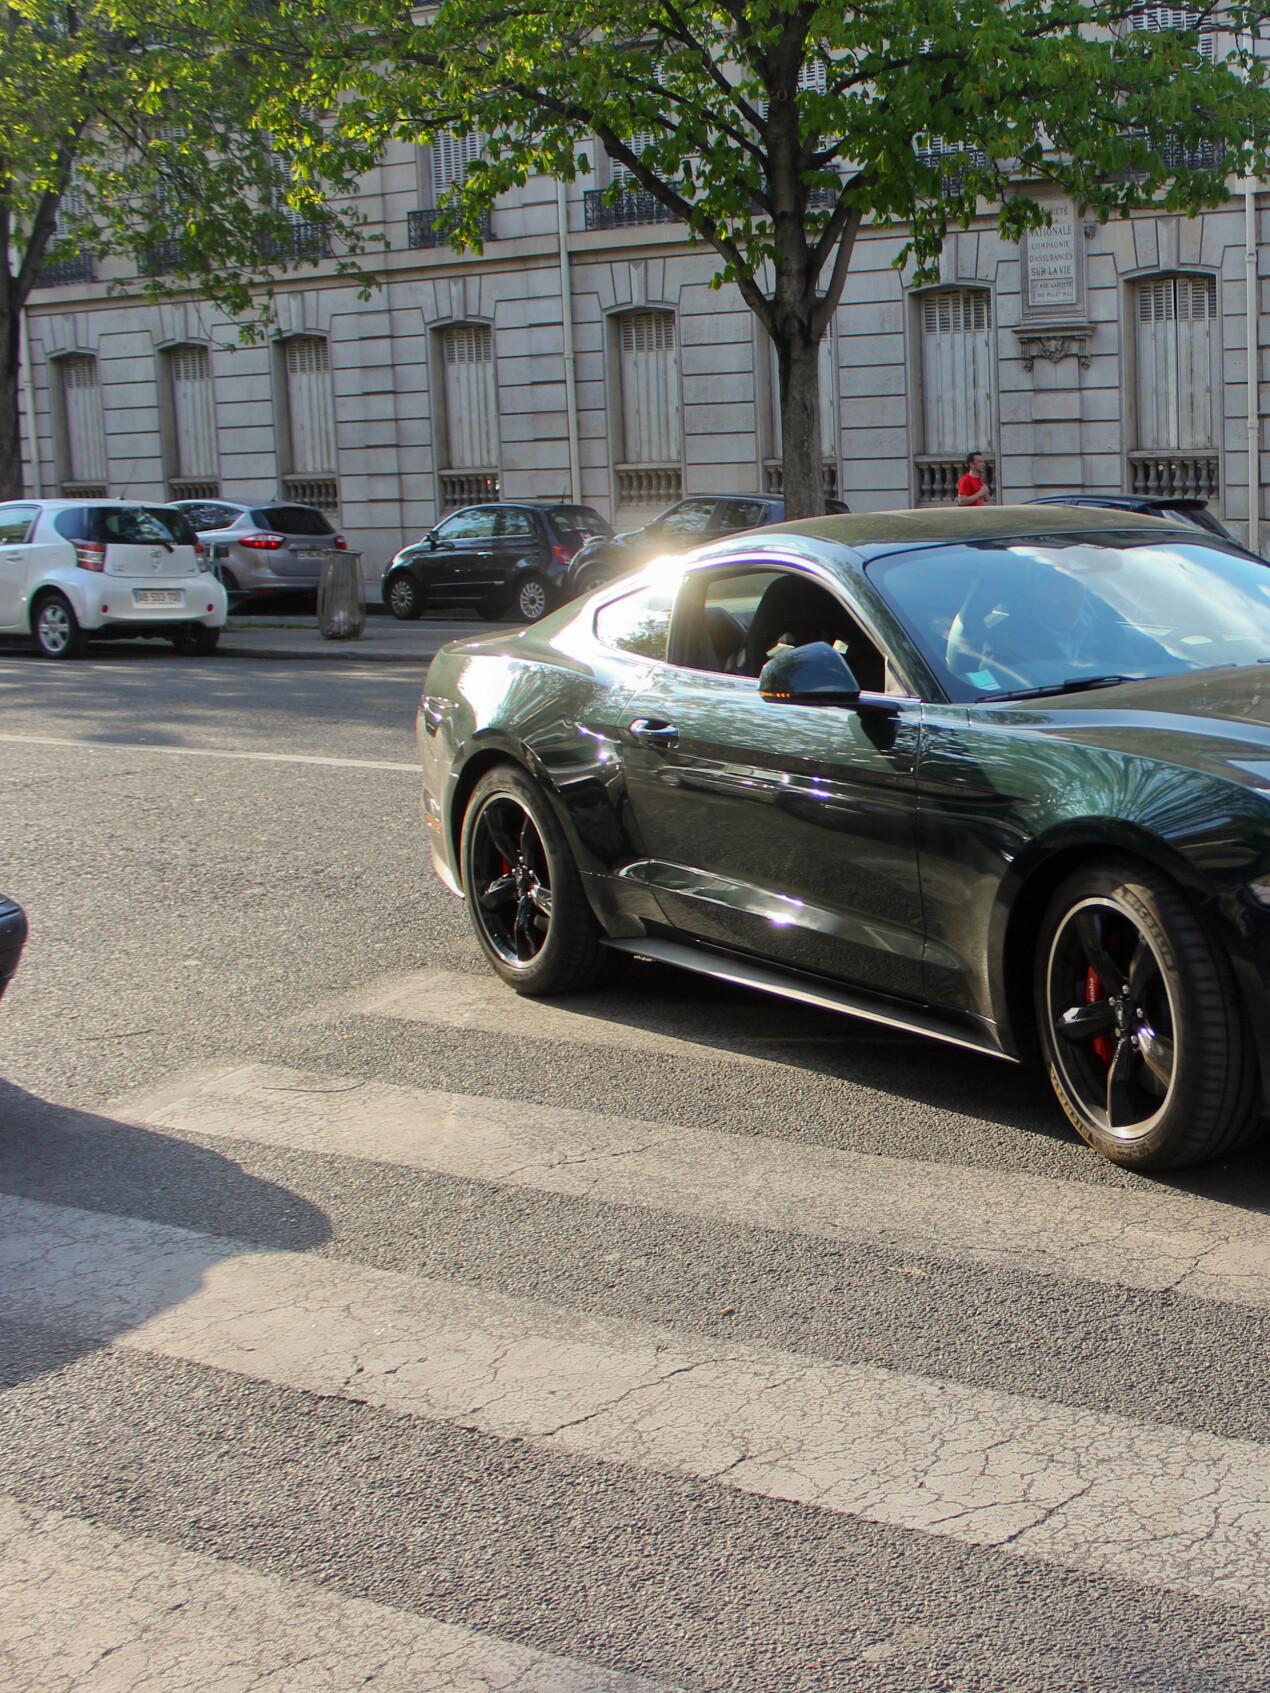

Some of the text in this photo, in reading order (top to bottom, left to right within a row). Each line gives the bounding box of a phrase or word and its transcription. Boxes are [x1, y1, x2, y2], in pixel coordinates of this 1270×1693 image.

[1031, 240, 1071, 251] COMPAGNIE
[1031, 265, 1072, 277] SUR LA VIE
